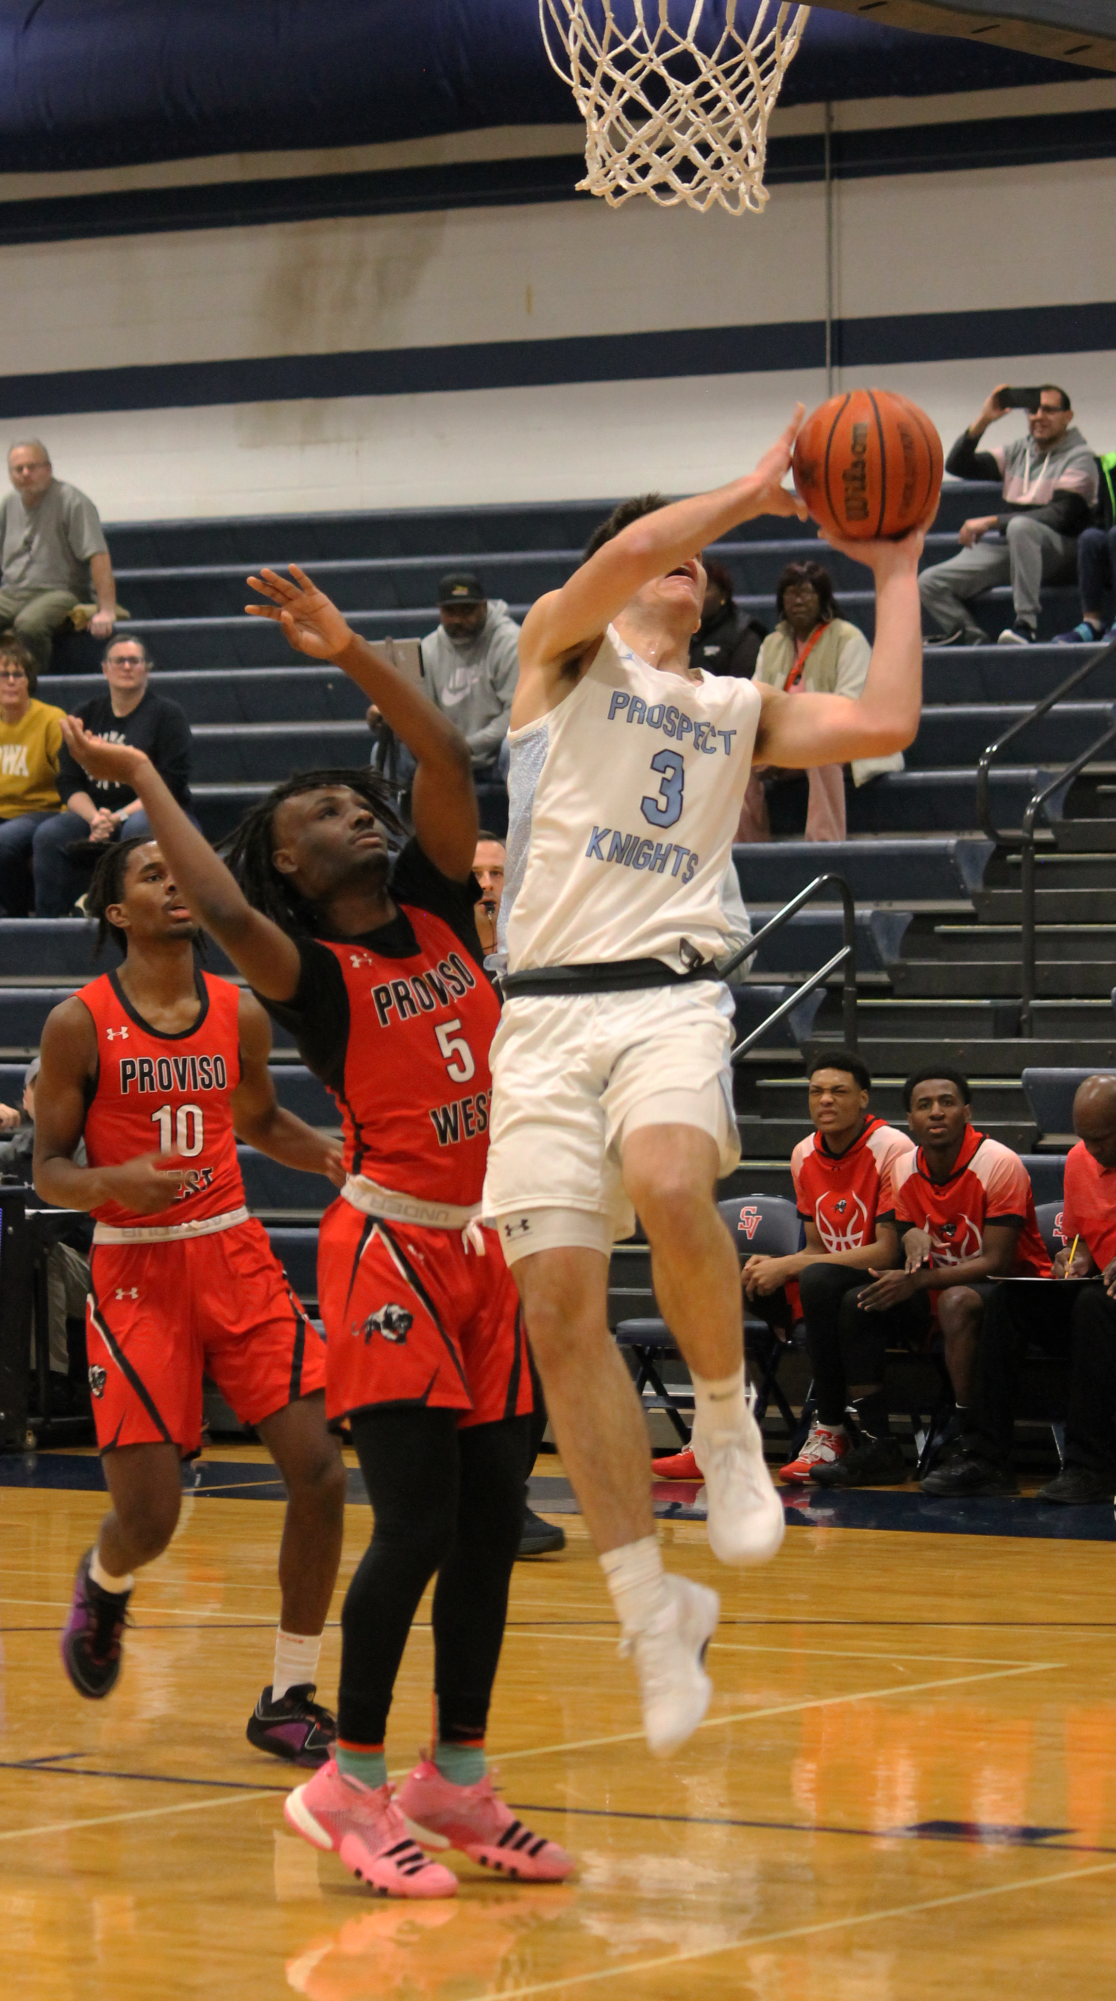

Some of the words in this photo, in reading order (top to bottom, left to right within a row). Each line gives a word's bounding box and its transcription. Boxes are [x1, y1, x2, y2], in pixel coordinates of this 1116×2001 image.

[842, 421, 869, 521] Wilson
[607, 691, 737, 756] PROSPECT
[0, 744, 29, 777] WA
[640, 748, 685, 829] 3
[585, 825, 699, 885] KNIGHTS
[371, 952, 476, 1028] PROVSO
[119, 1054, 227, 1095] PROVISO
[434, 1018, 476, 1083] 5
[151, 1103, 204, 1158] 10
[429, 1091, 493, 1147] WES
[157, 1167, 214, 1203] EST
[370, 1196, 450, 1223] UNDER
[737, 1205, 762, 1240] SV
